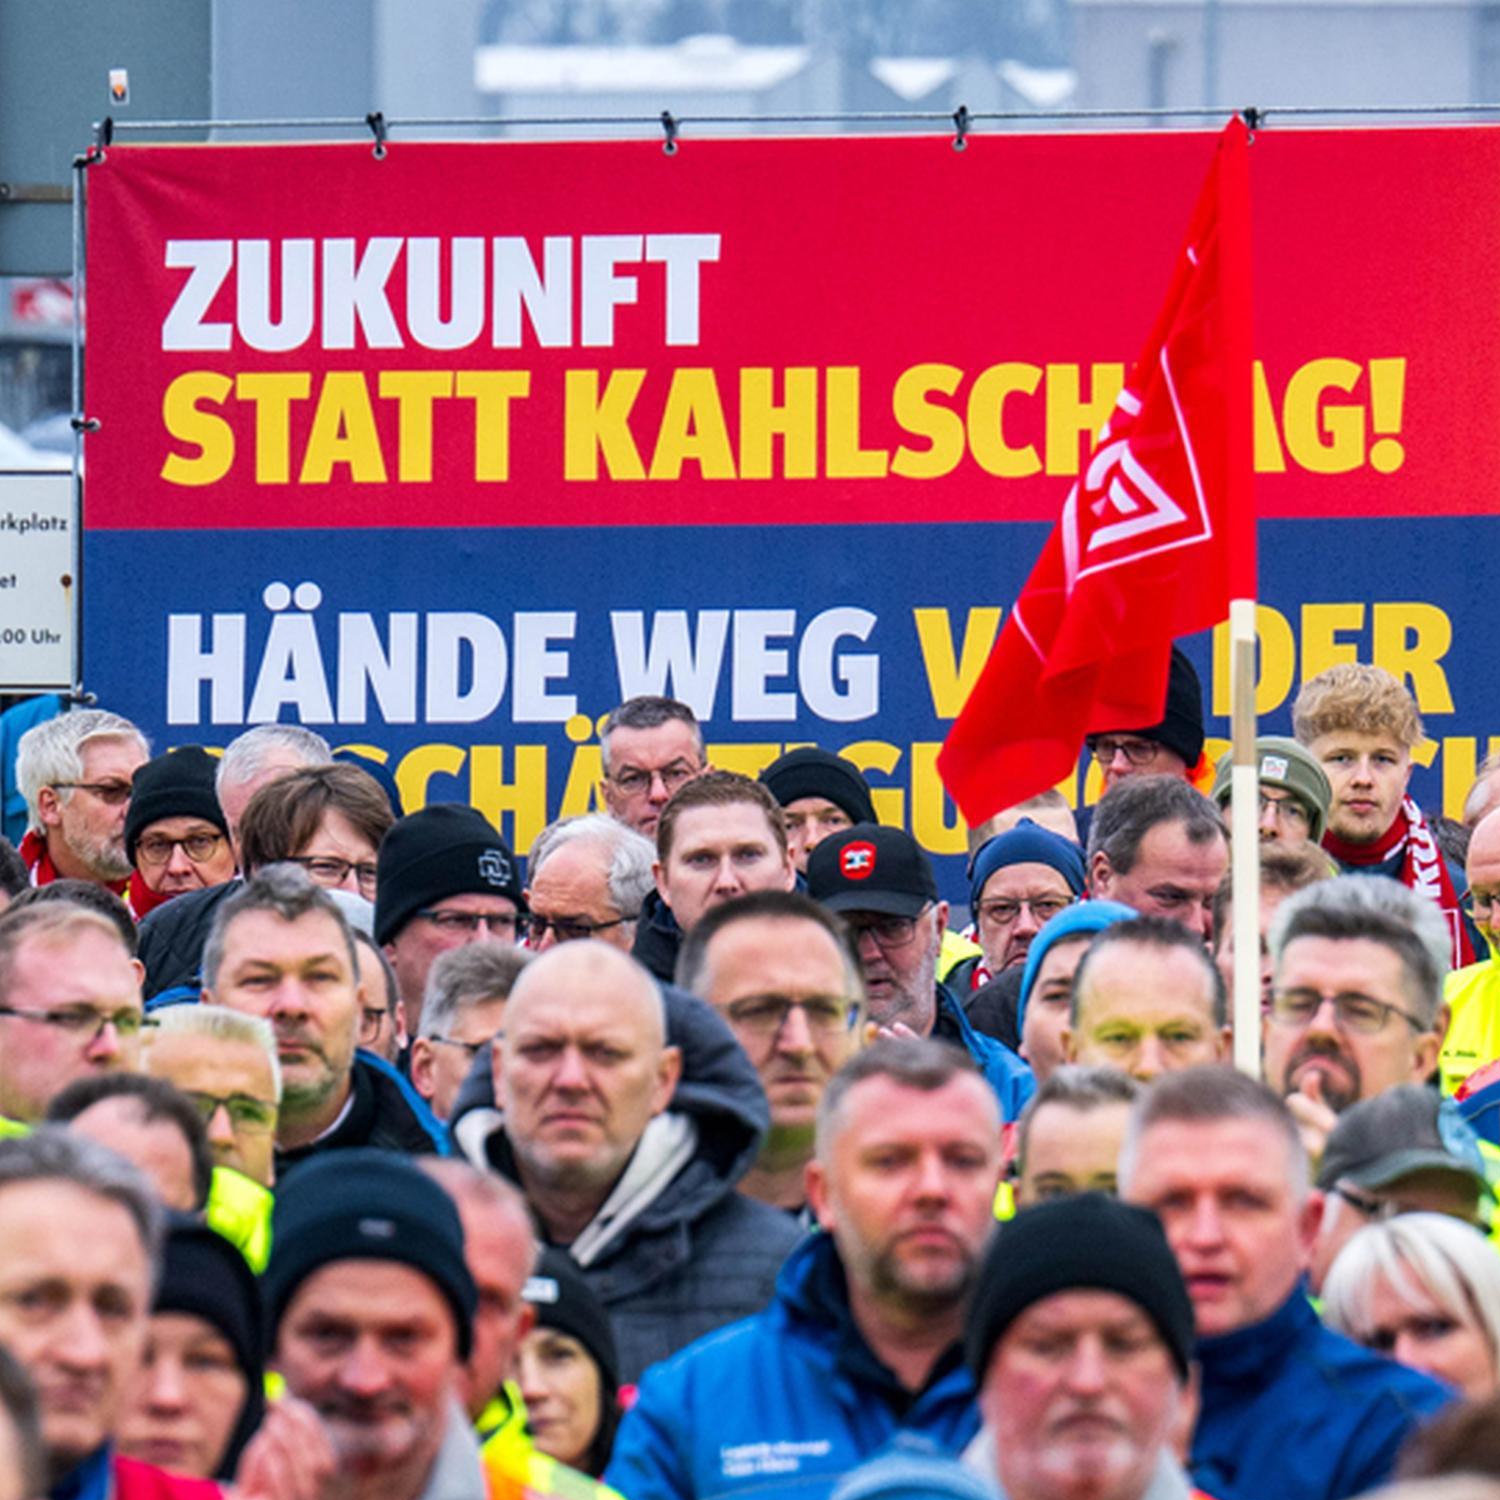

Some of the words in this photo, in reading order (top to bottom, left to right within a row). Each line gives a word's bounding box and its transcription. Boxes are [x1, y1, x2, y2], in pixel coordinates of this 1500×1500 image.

[162, 234, 721, 352] ZUKUNFT
[160, 371, 531, 486] STATT
[564, 357, 1406, 481] KAHLSCHG!
[31, 627, 61, 644] Uhr
[167, 582, 577, 725] HÄNDE
[611, 607, 879, 722] WEG
